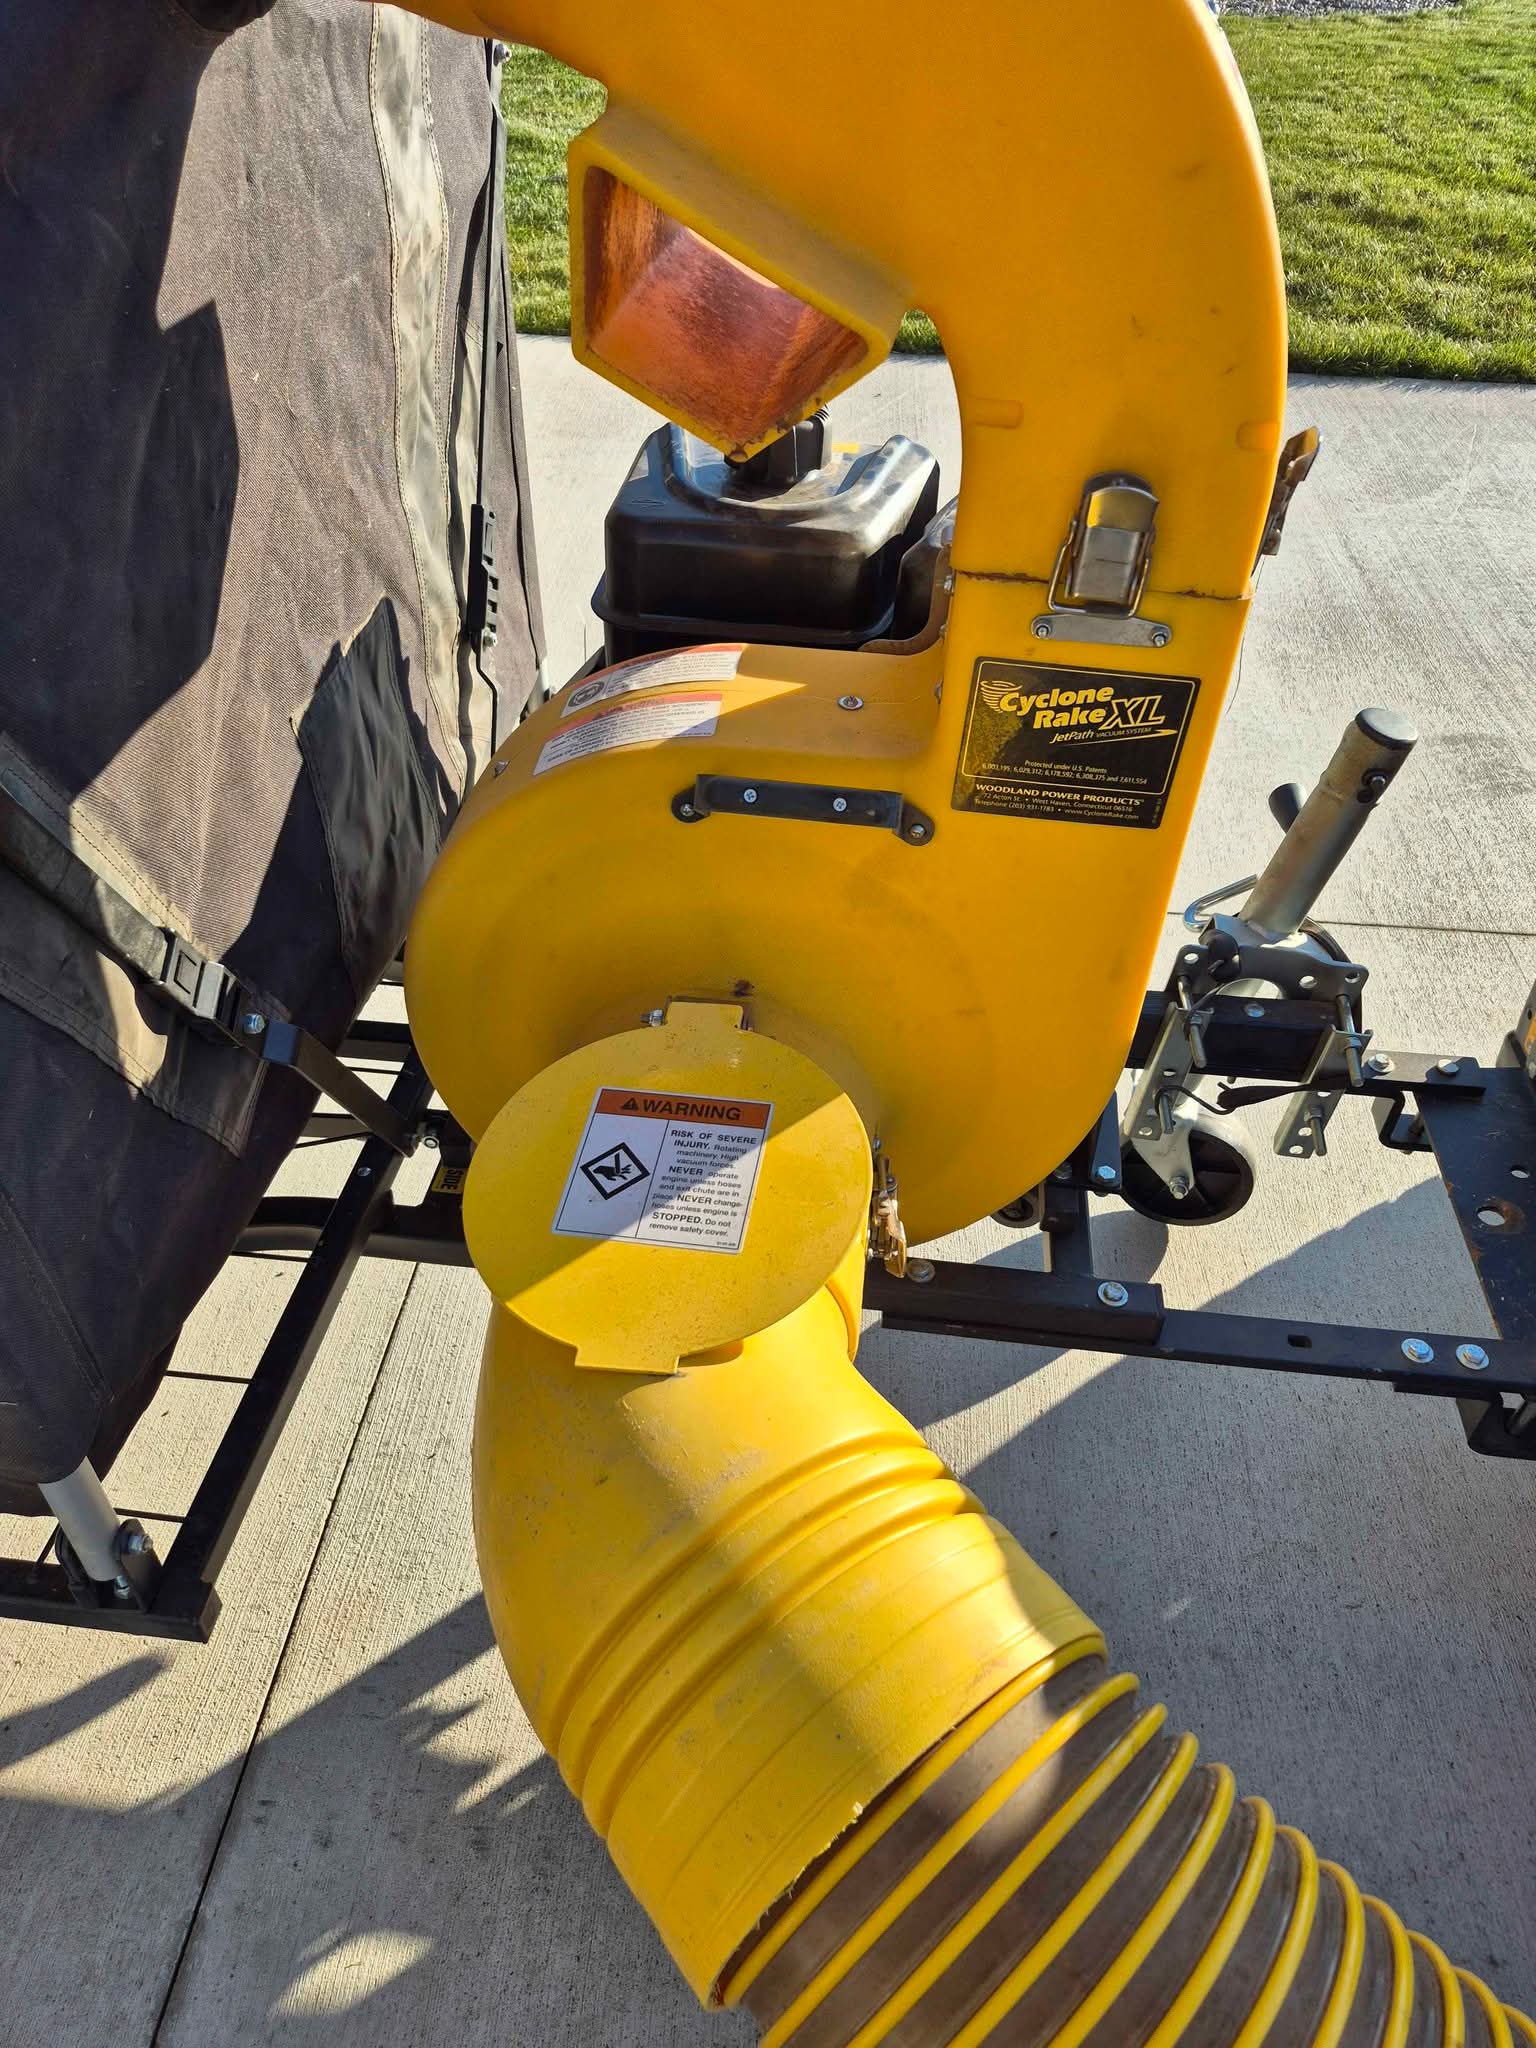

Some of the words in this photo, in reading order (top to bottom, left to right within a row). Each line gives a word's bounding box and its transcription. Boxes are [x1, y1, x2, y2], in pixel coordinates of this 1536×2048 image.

[1000, 687, 1114, 717] Cyclone
[1032, 707, 1106, 729] Rake
[1098, 695, 1166, 730] XL
[1049, 729, 1095, 744] JetPath
[1096, 729, 1126, 738] VACUUM
[1126, 727, 1152, 736] SYSTEM
[1025, 760, 1053, 769] Protected
[1053, 762, 1071, 770] under
[1072, 764, 1083, 772] U.S.
[1085, 766, 1107, 774] Patents
[975, 783, 1040, 797] WOODLAND
[1041, 790, 1080, 801] POWER
[975, 798, 1008, 808] Telephone
[1050, 799, 1072, 807] Haven,
[1073, 801, 1112, 811] Connecticut
[643, 1099, 742, 1121] WARNING
[671, 1129, 694, 1139] RISK
[698, 1132, 713, 1140] OF
[717, 1134, 758, 1145] SEVERE
[713, 1144, 748, 1154] Rotating
[709, 1161, 736, 1169] forces.
[720, 1154, 739, 1162] High
[668, 1165, 704, 1176] NEVER
[707, 1170, 739, 1180] operate
[659, 1182, 675, 1191] and
[692, 1186, 716, 1195] chute
[731, 1189, 740, 1197] in
[661, 1175, 688, 1184] engine
[690, 1178, 716, 1186] unless
[717, 1180, 742, 1189] hoses
[677, 1194, 713, 1205] NEVER
[651, 1202, 675, 1210] hoses
[676, 1205, 701, 1213] unless
[702, 1208, 729, 1216] engine
[652, 1211, 703, 1224] STOPPED.
[704, 1218, 717, 1226] Do
[718, 1219, 731, 1228] not
[649, 1222, 678, 1232] remove
[680, 1225, 704, 1235] safety
[705, 1228, 729, 1237] cover.
